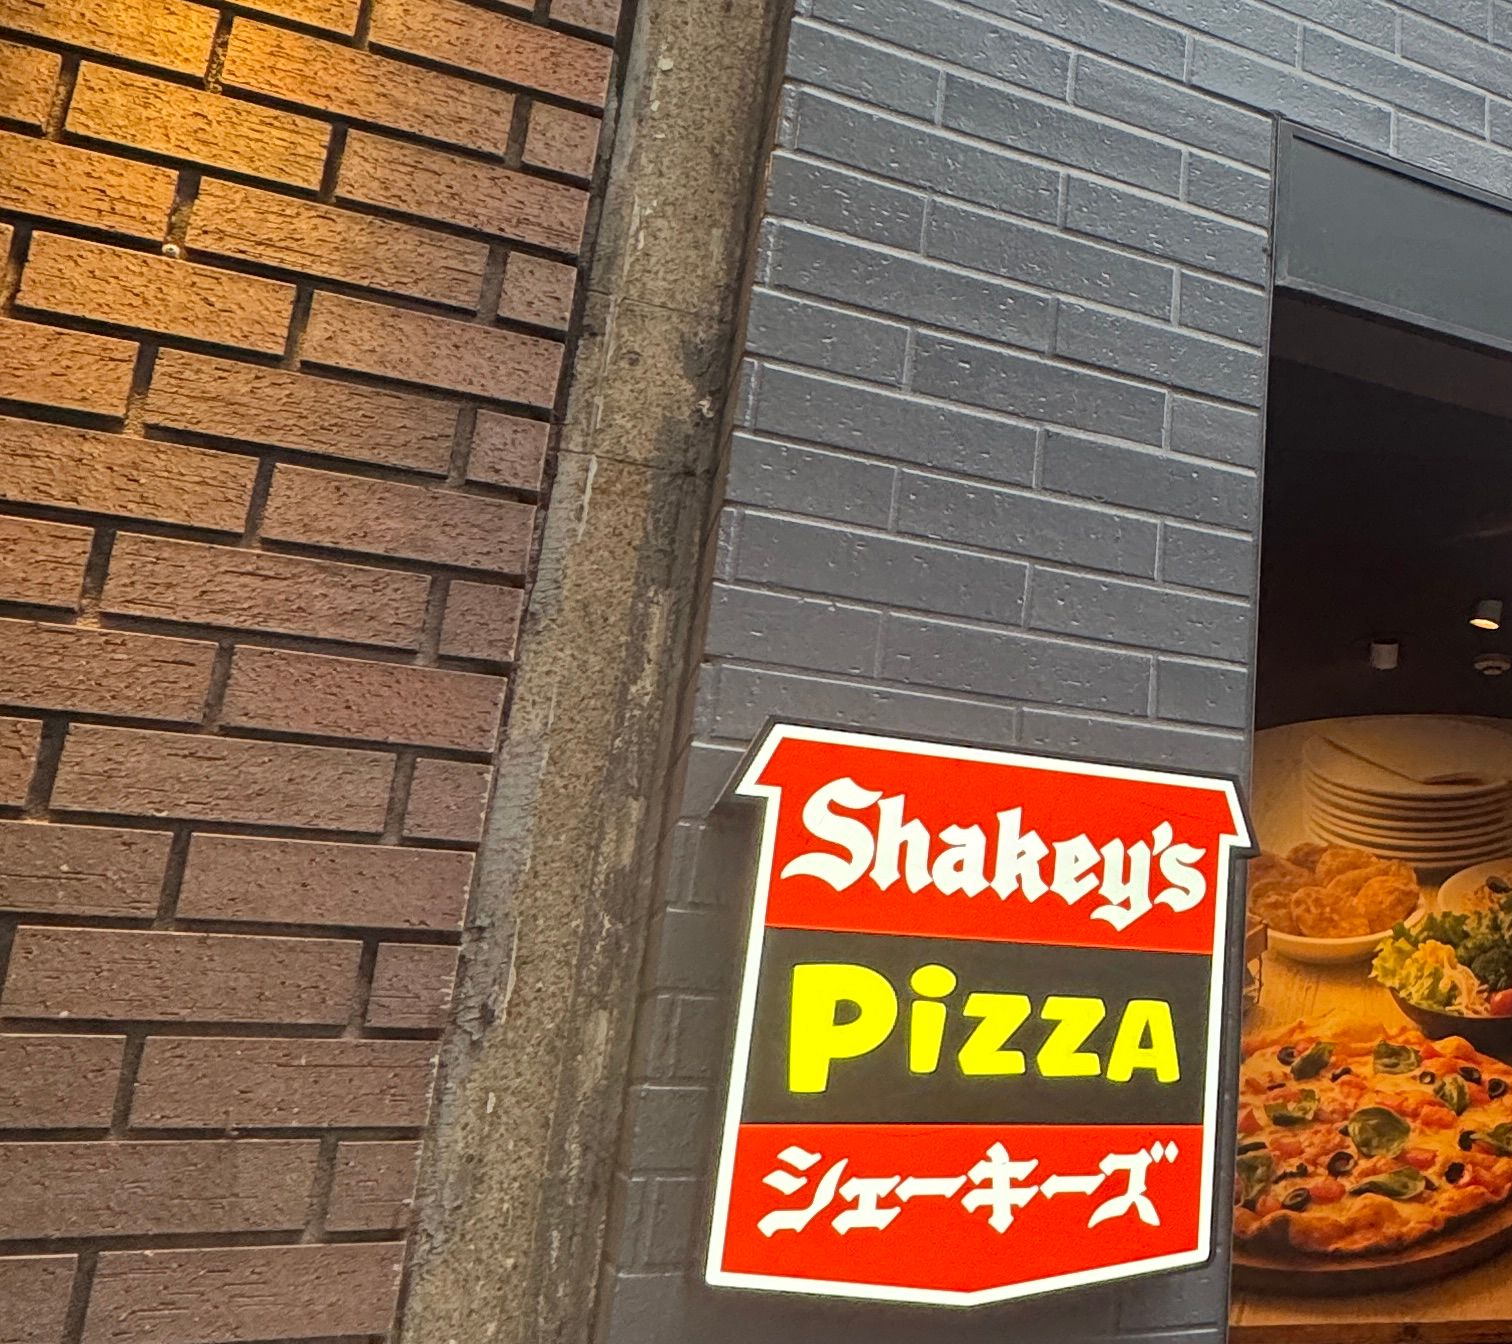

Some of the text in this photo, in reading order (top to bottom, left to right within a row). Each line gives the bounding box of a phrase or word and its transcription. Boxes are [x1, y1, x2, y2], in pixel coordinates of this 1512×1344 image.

[781, 776, 1206, 932] Shakey's
[757, 1140, 1179, 1238] シェーキーズ
